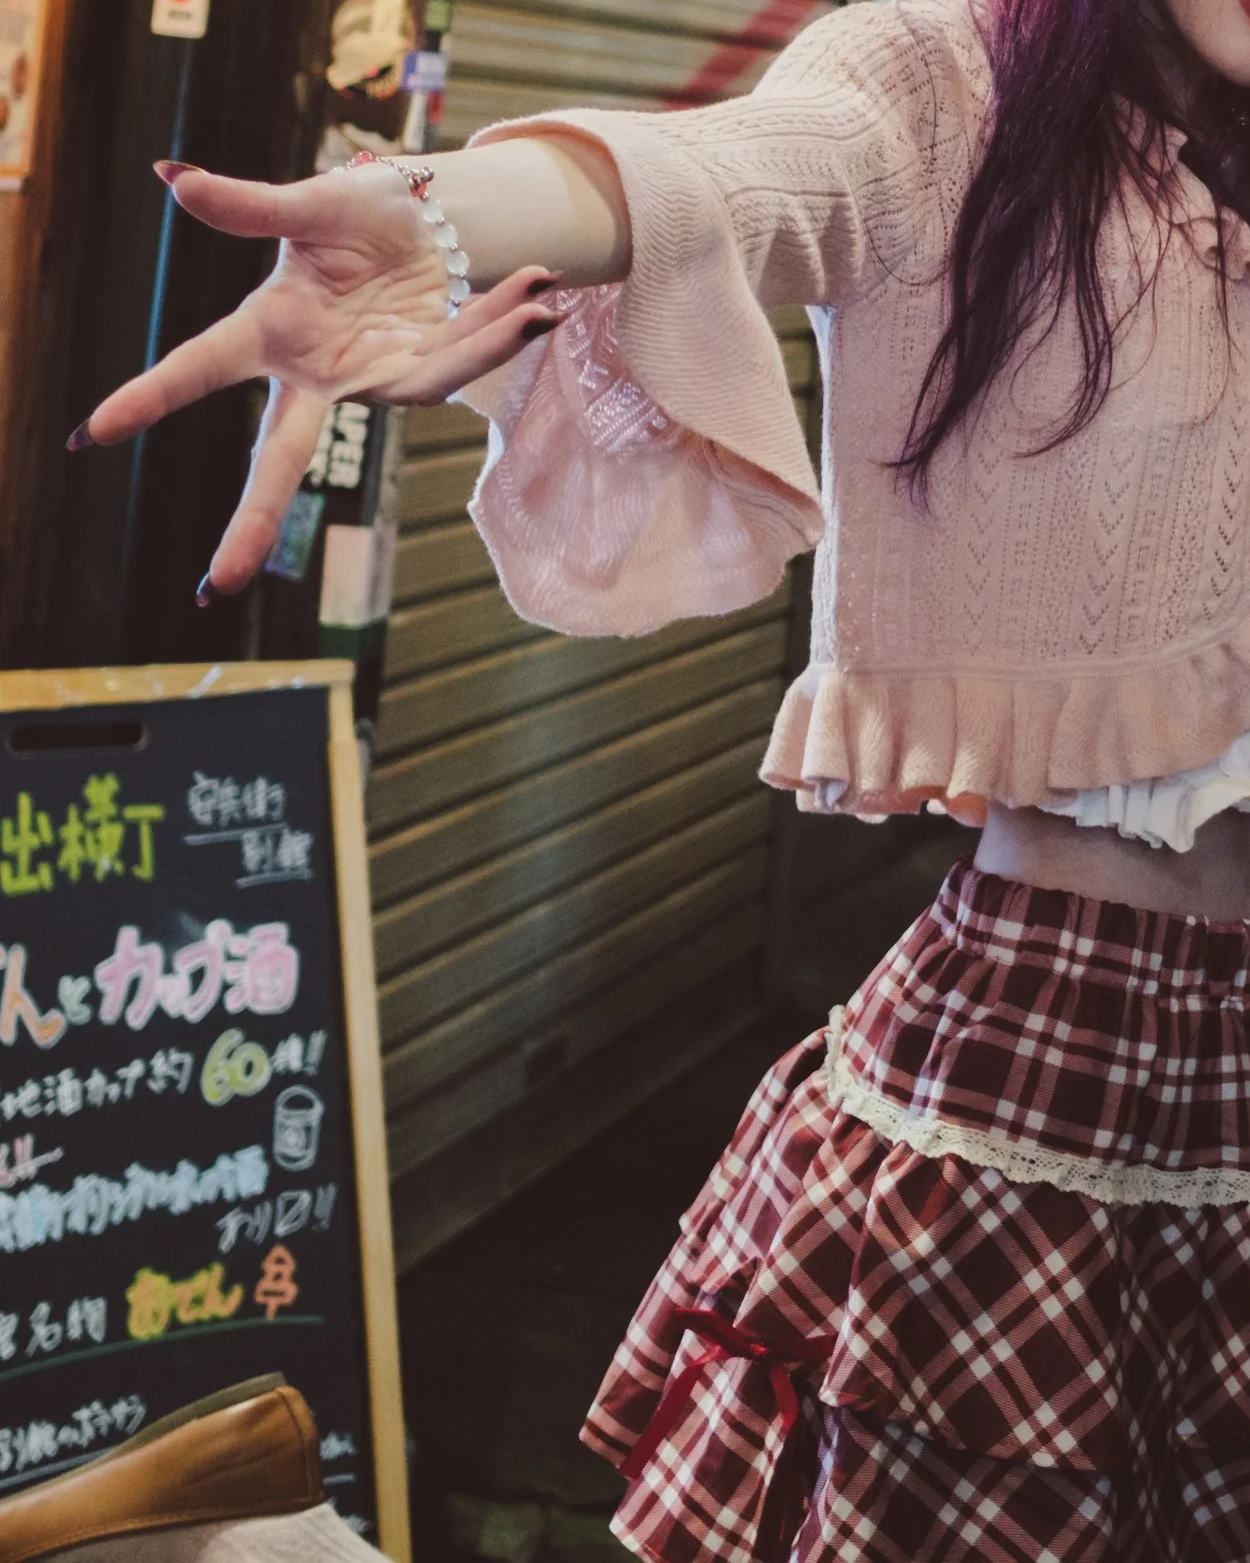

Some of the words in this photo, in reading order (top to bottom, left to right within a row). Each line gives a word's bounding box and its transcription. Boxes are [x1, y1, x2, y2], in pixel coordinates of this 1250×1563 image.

[0, 918, 299, 1048] んとカップ酒
[125, 1261, 243, 1339] おでん
